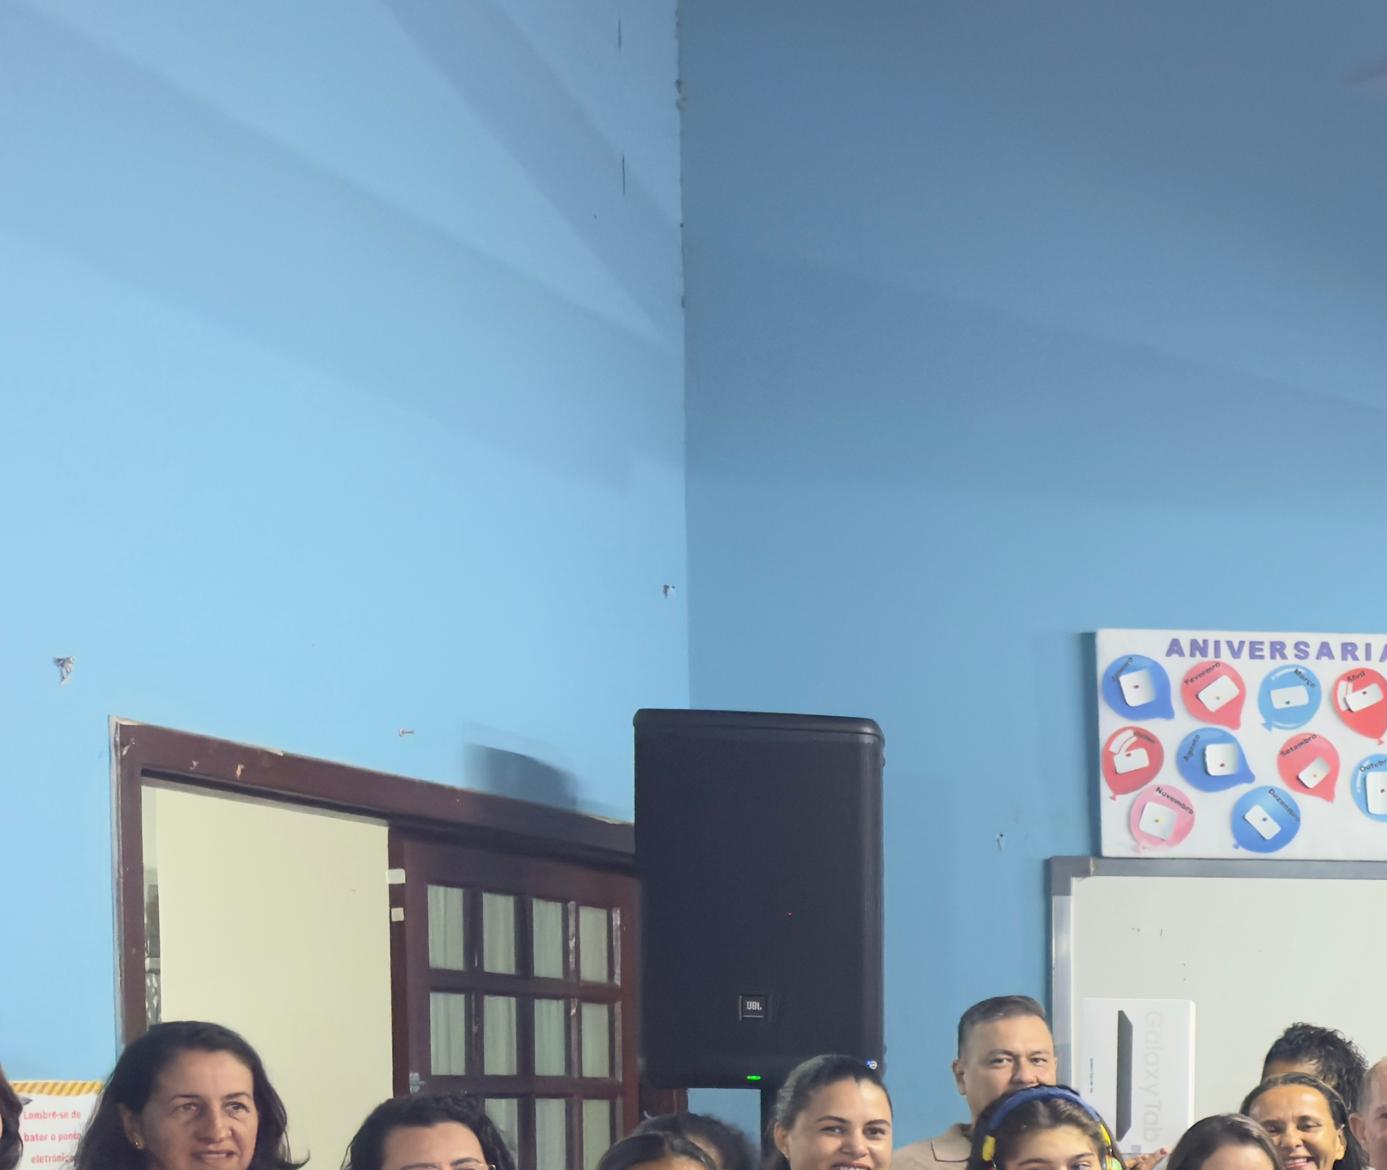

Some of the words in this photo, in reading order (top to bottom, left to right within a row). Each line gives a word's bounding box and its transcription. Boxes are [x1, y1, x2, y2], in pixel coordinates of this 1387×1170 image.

[1155, 786, 1194, 815] Novembro
[1139, 1010, 1163, 1097] Galaxy
[1143, 1101, 1163, 1143] Tab
